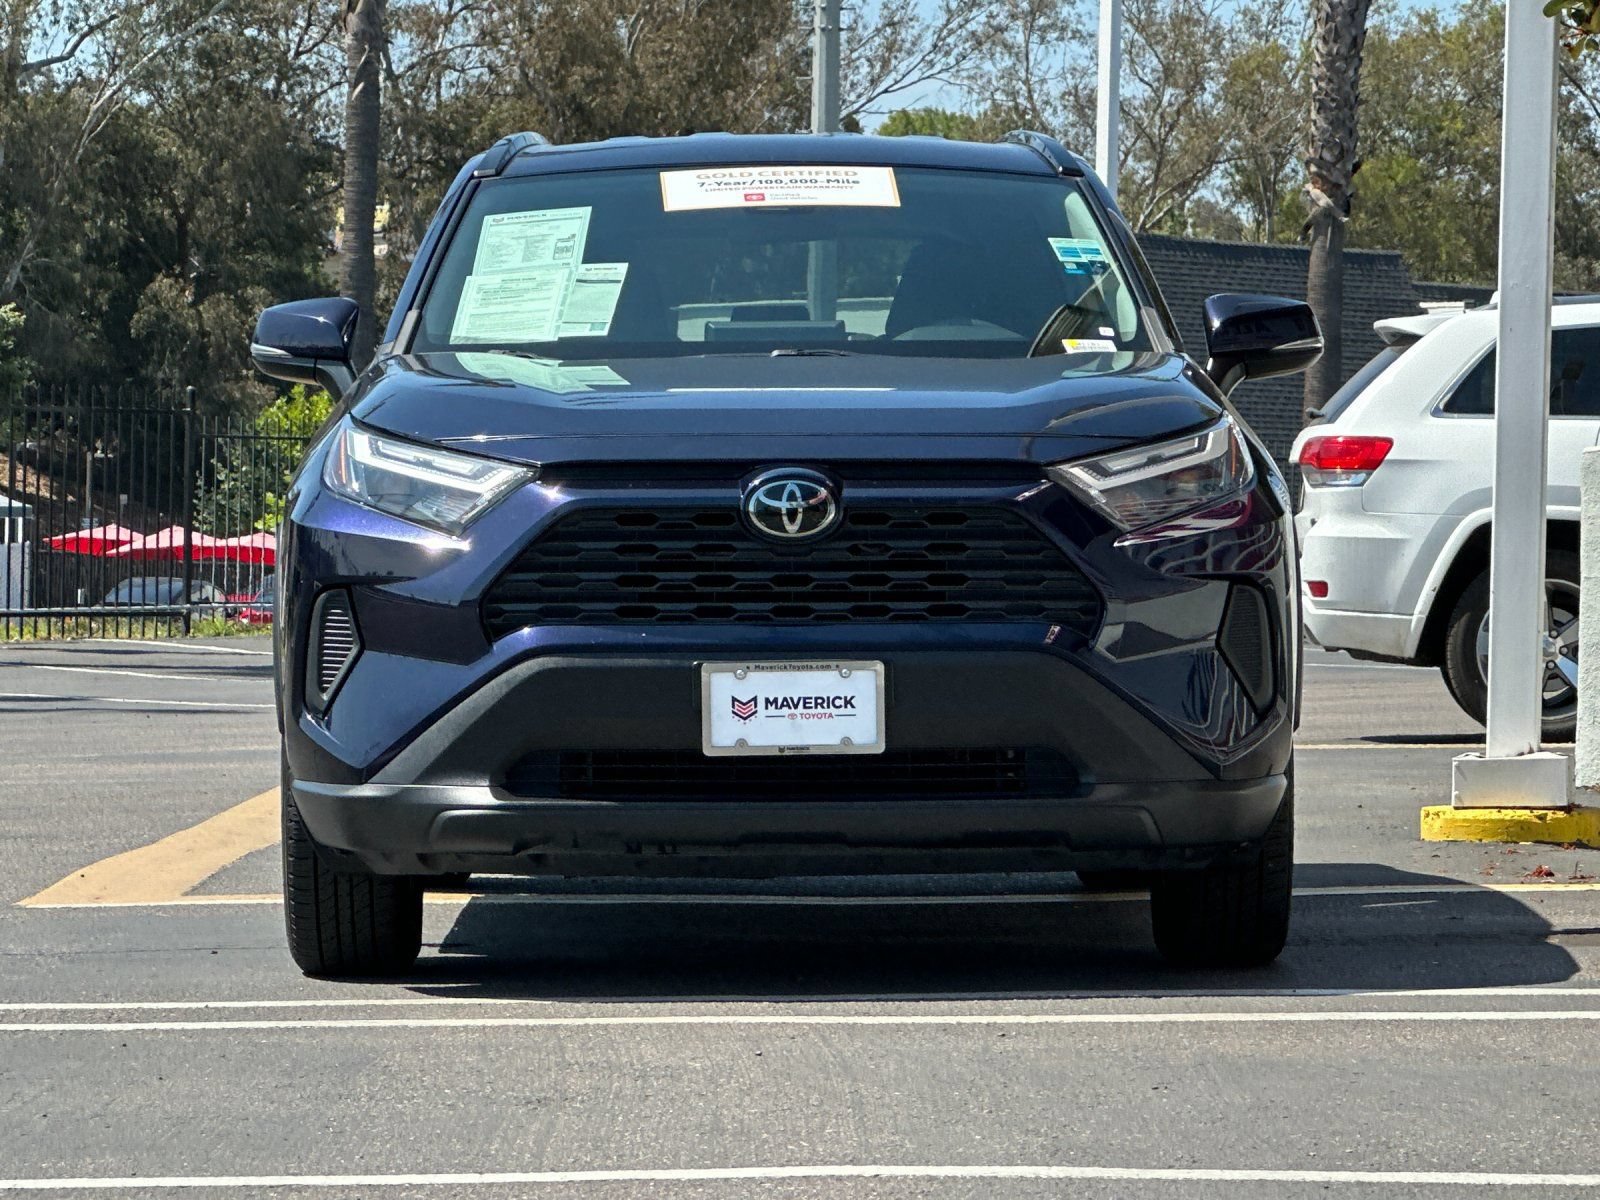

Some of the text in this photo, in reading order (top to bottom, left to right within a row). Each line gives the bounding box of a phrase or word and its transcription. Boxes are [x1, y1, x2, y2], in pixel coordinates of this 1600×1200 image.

[696, 170, 859, 179] GOLD CERTIFIED
[697, 178, 860, 188] 7-Year/100,000-Mile
[754, 663, 832, 671] MaverickToyota.com
[764, 696, 856, 710] MAVERICK
[799, 712, 835, 720] TOYOTA
